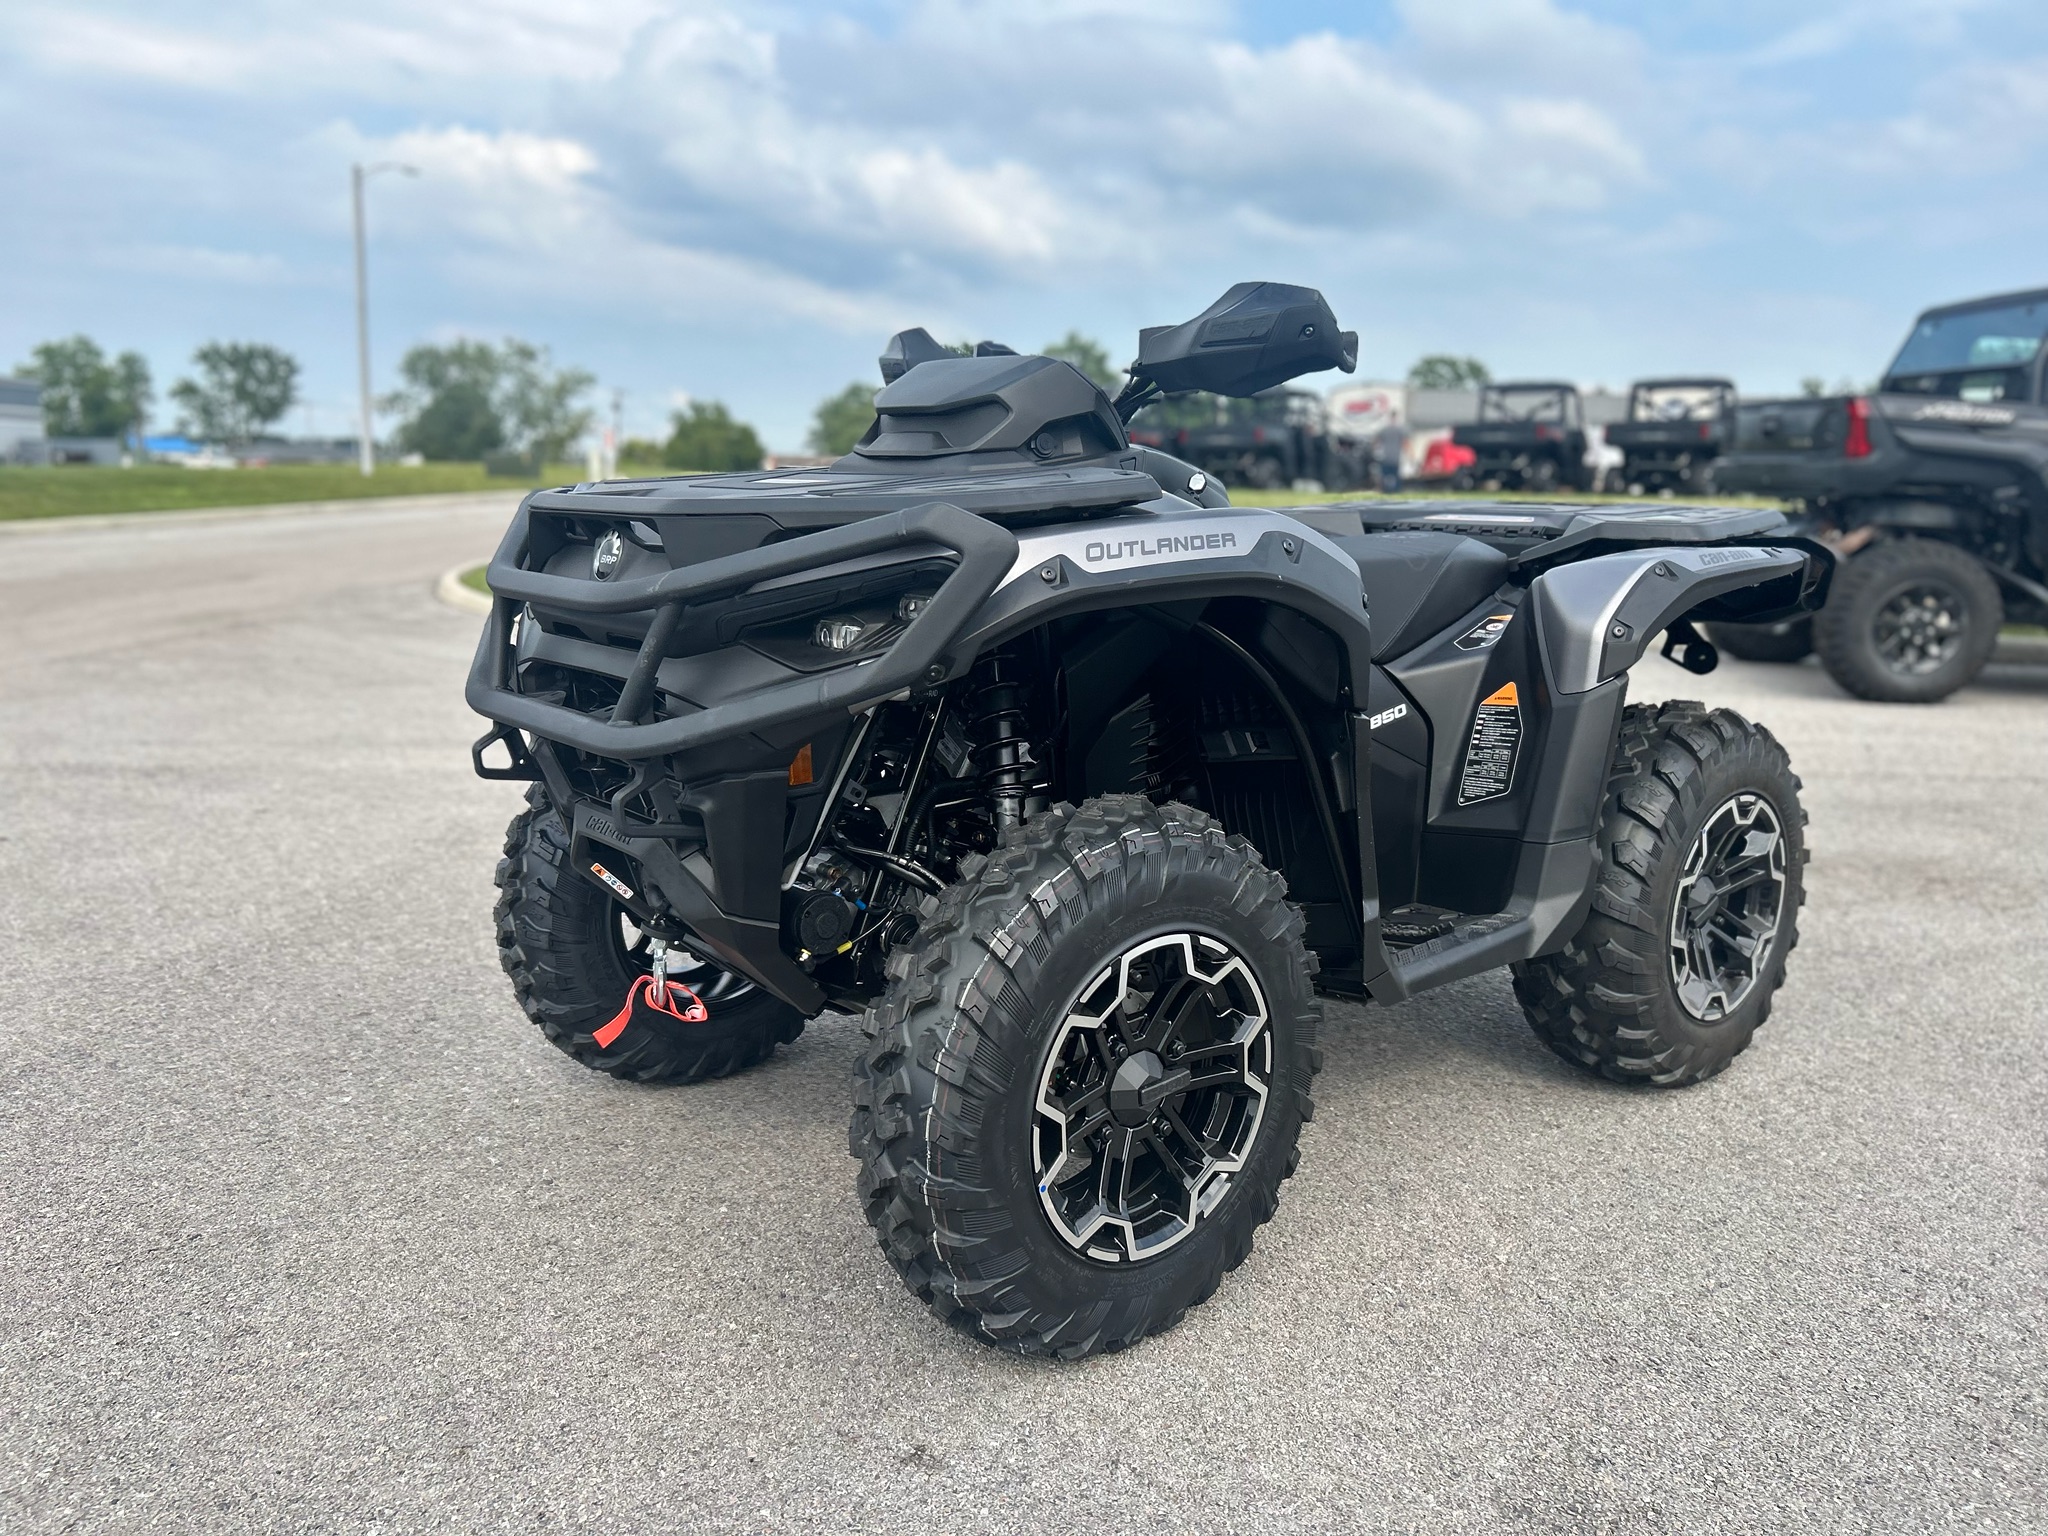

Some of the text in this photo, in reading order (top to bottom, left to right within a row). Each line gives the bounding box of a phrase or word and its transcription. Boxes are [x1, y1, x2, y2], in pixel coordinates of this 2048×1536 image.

[600, 554, 618, 565] BRP
[1085, 532, 1237, 563] OUTLANDER
[1370, 703, 1407, 730] 850
